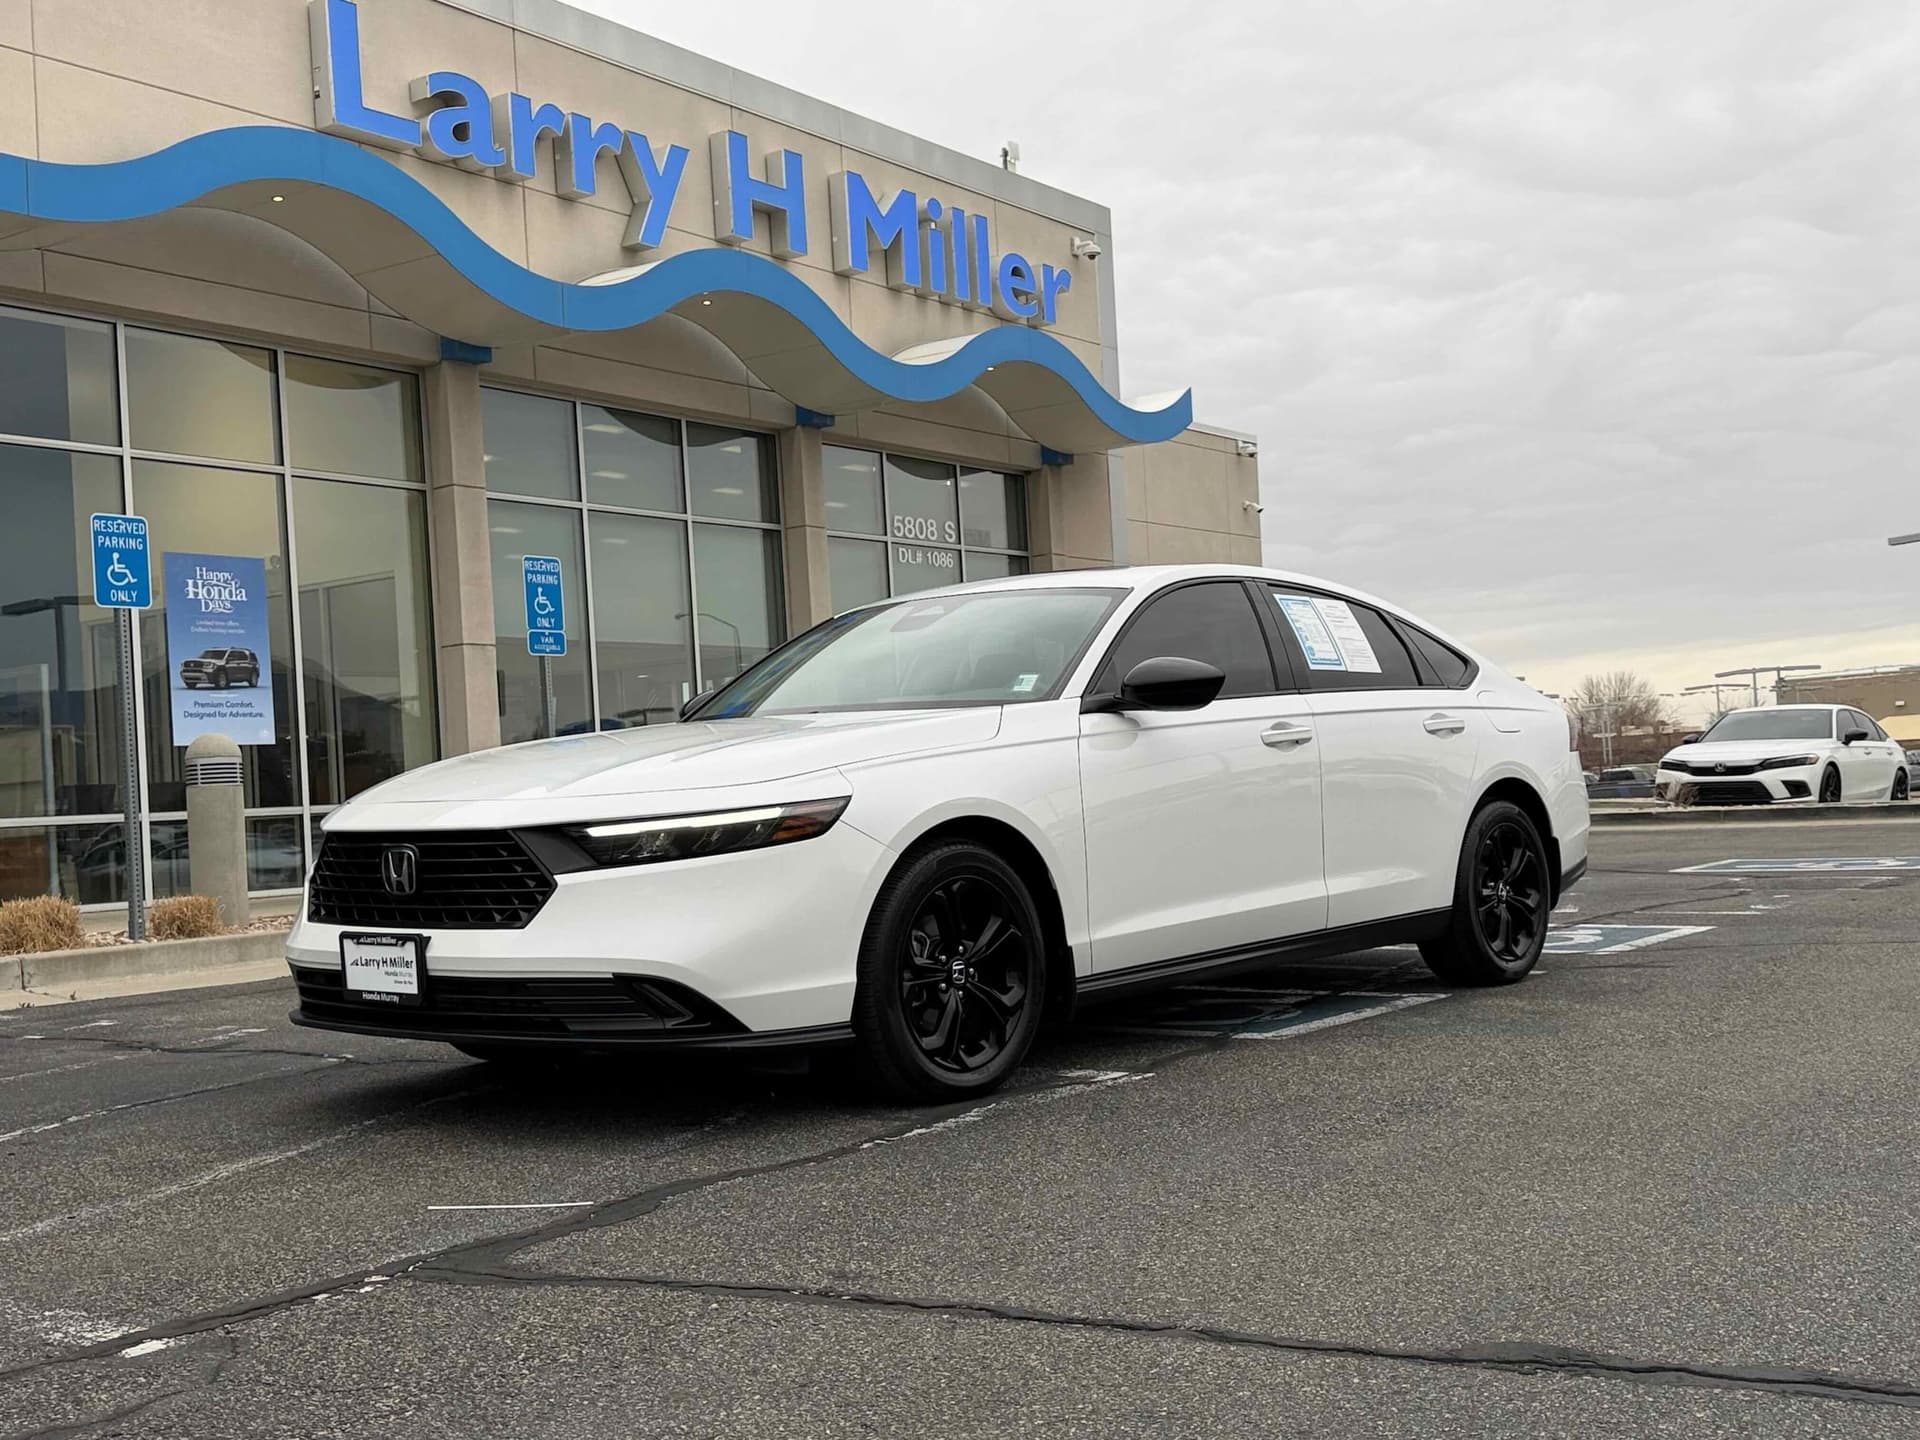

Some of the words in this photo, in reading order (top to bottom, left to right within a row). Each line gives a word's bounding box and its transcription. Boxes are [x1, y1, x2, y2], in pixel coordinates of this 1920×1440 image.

[318, 0, 691, 249] Larry
[721, 130, 808, 257] H
[836, 170, 1073, 326] Miller
[93, 520, 145, 535] RESERVED
[893, 515, 938, 540] 5808
[944, 521, 956, 542] S
[98, 536, 143, 550] PARKING
[898, 547, 922, 565] DL#
[927, 551, 954, 568] 1086
[524, 560, 559, 572] RESERVED
[195, 566, 234, 586] Happy
[528, 573, 558, 585] PARKING
[110, 589, 138, 602] ONLY
[184, 578, 248, 602] Honda
[201, 599, 234, 614] Days
[536, 617, 555, 628] ONLY
[540, 636, 555, 644] VAN
[193, 700, 224, 708] Premium
[183, 710, 217, 720] Designed
[218, 710, 228, 718] for
[229, 710, 265, 719] Adventure.
[360, 956, 380, 970] Larry
[381, 957, 389, 968] H
[389, 957, 414, 969] Miller
[362, 991, 380, 1001] Honda
